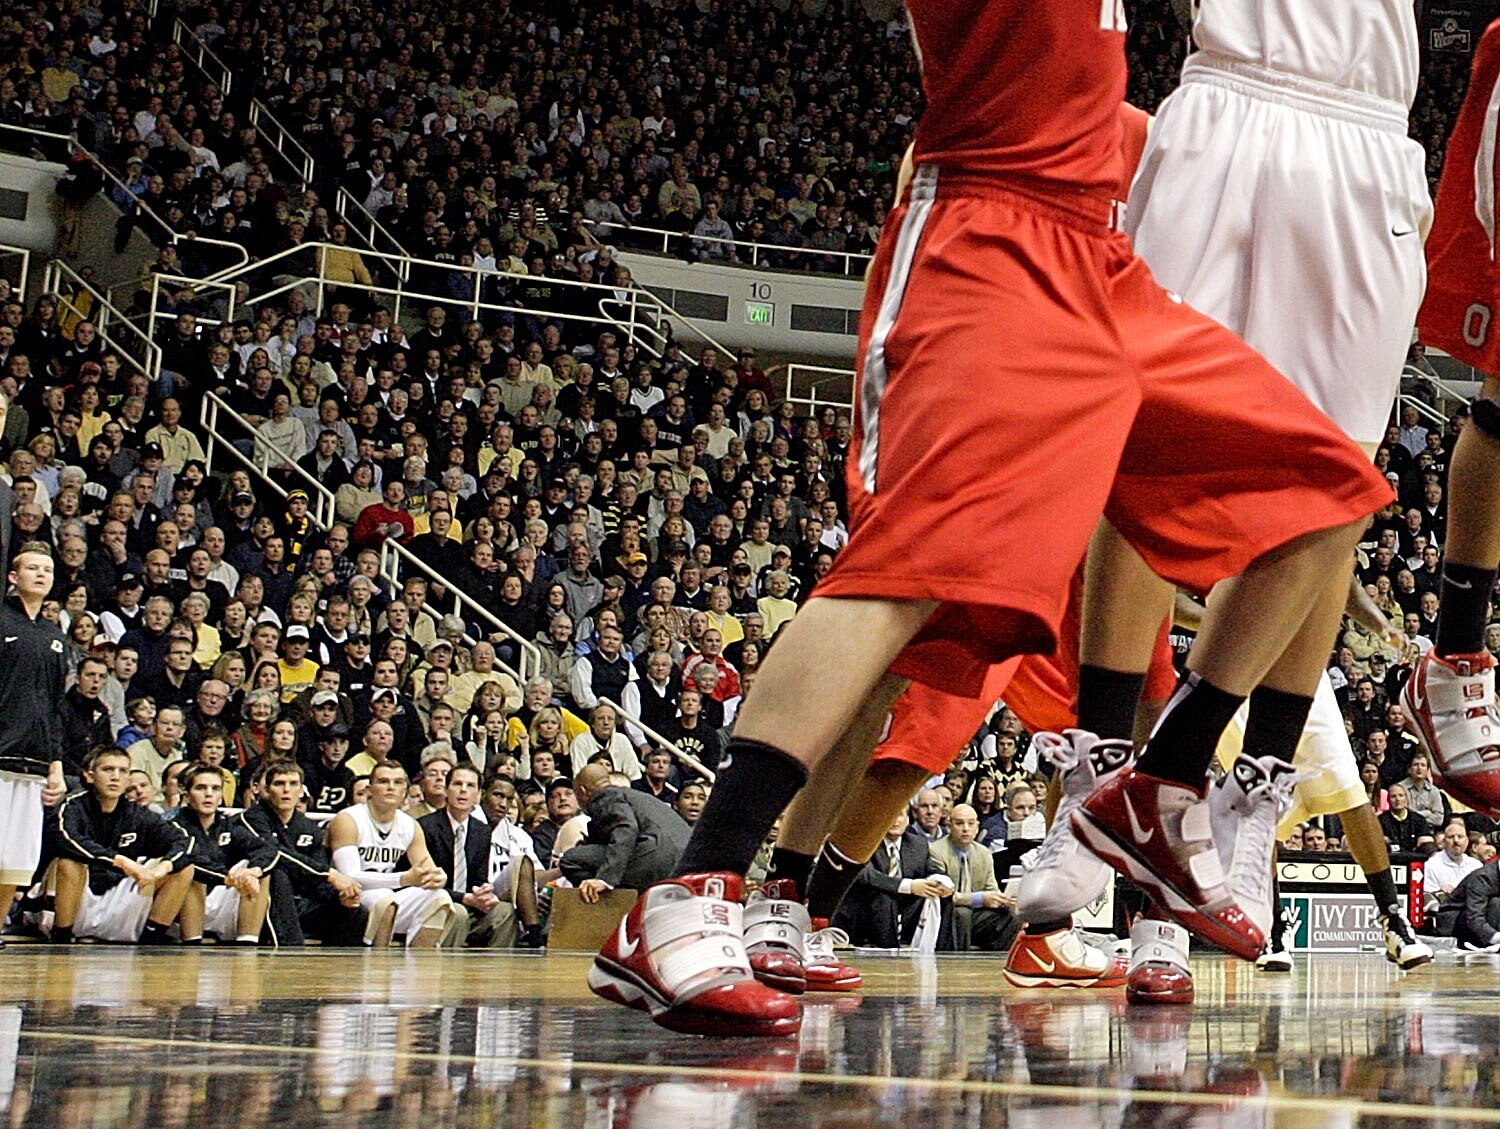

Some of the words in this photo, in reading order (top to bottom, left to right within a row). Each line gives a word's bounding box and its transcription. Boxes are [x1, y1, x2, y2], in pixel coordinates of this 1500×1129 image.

[750, 282, 772, 300] 10
[1314, 904, 1349, 930] IVY
[1313, 930, 1366, 943] COMMUNITY
